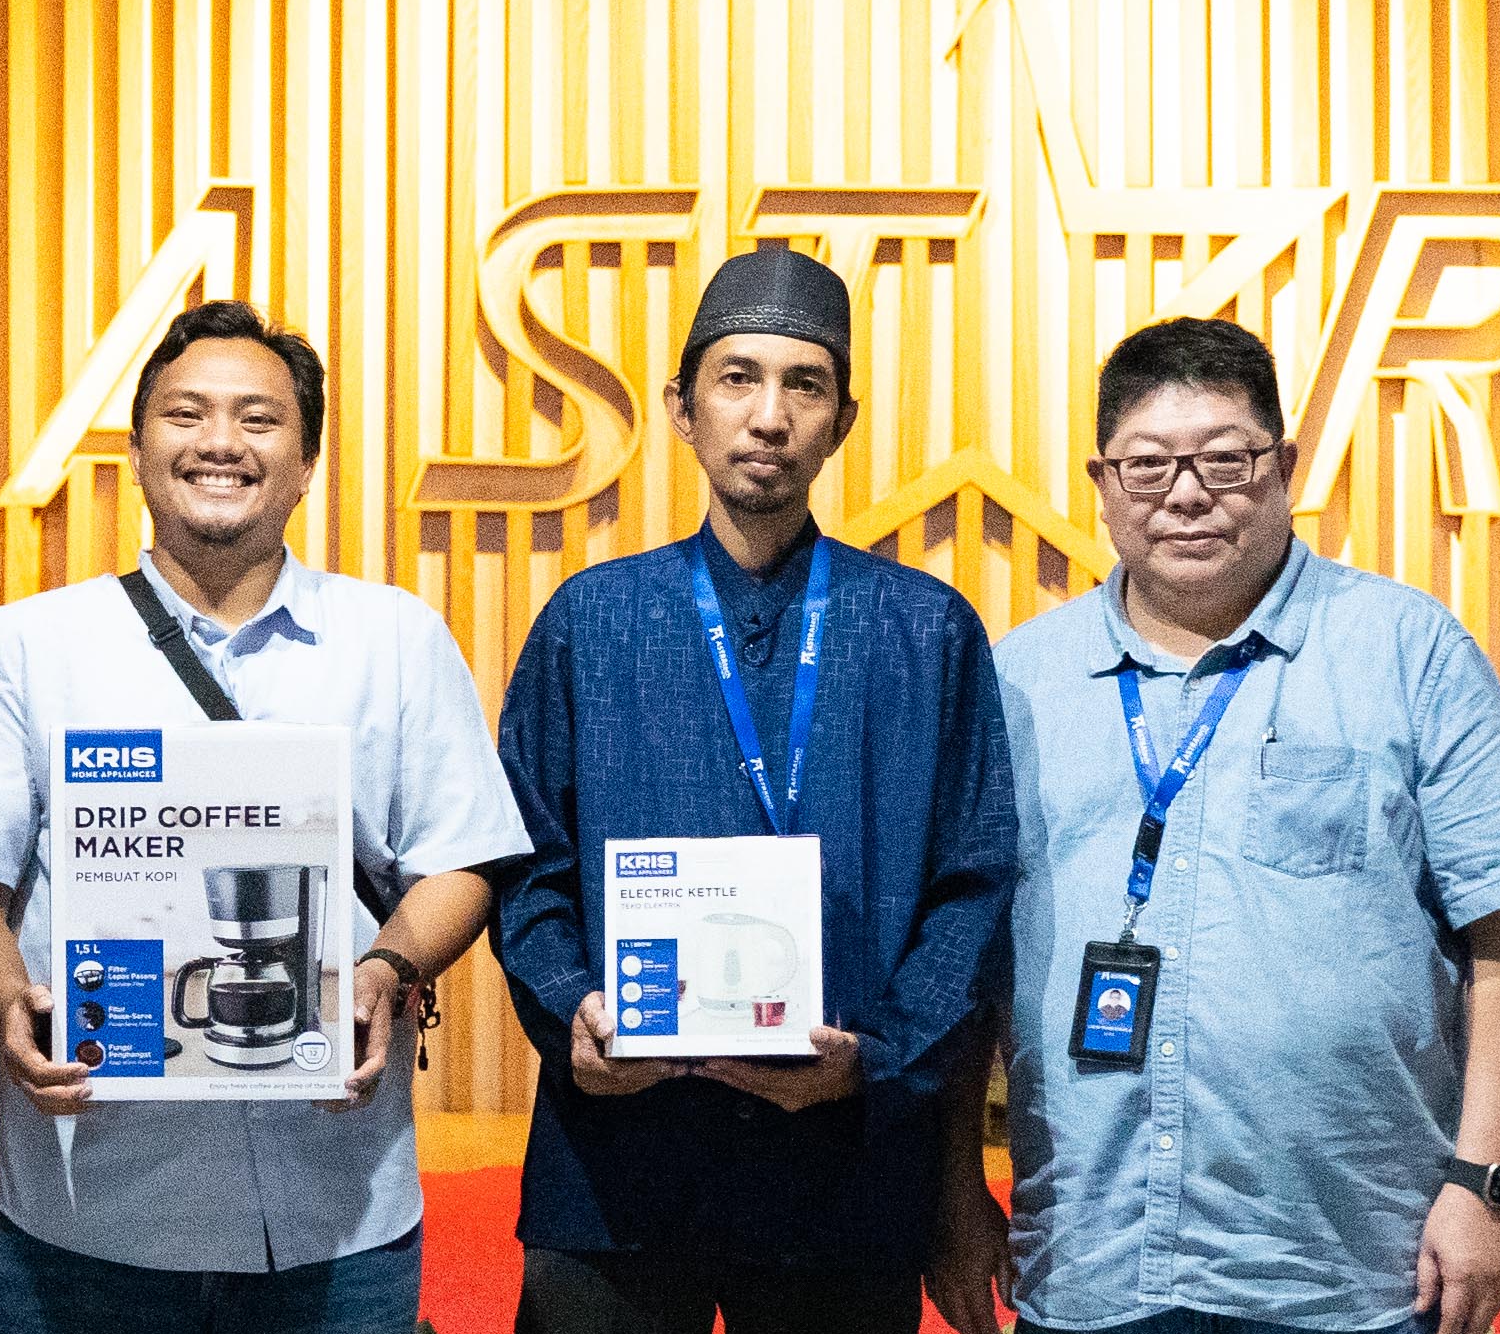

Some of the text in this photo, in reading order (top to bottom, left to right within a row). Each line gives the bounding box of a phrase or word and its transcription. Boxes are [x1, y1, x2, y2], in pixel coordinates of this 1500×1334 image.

[71, 746, 157, 768] KRIS
[71, 770, 157, 779] HOME APPLIANCES
[74, 805, 282, 829] DRIP COFFEE
[74, 836, 184, 859] MAKER
[619, 854, 674, 869] KRIS
[75, 871, 178, 883] PEMBUAT KOPI
[620, 886, 737, 899] ELECTRIC KETTLE
[75, 944, 101, 955] 1,5 L
